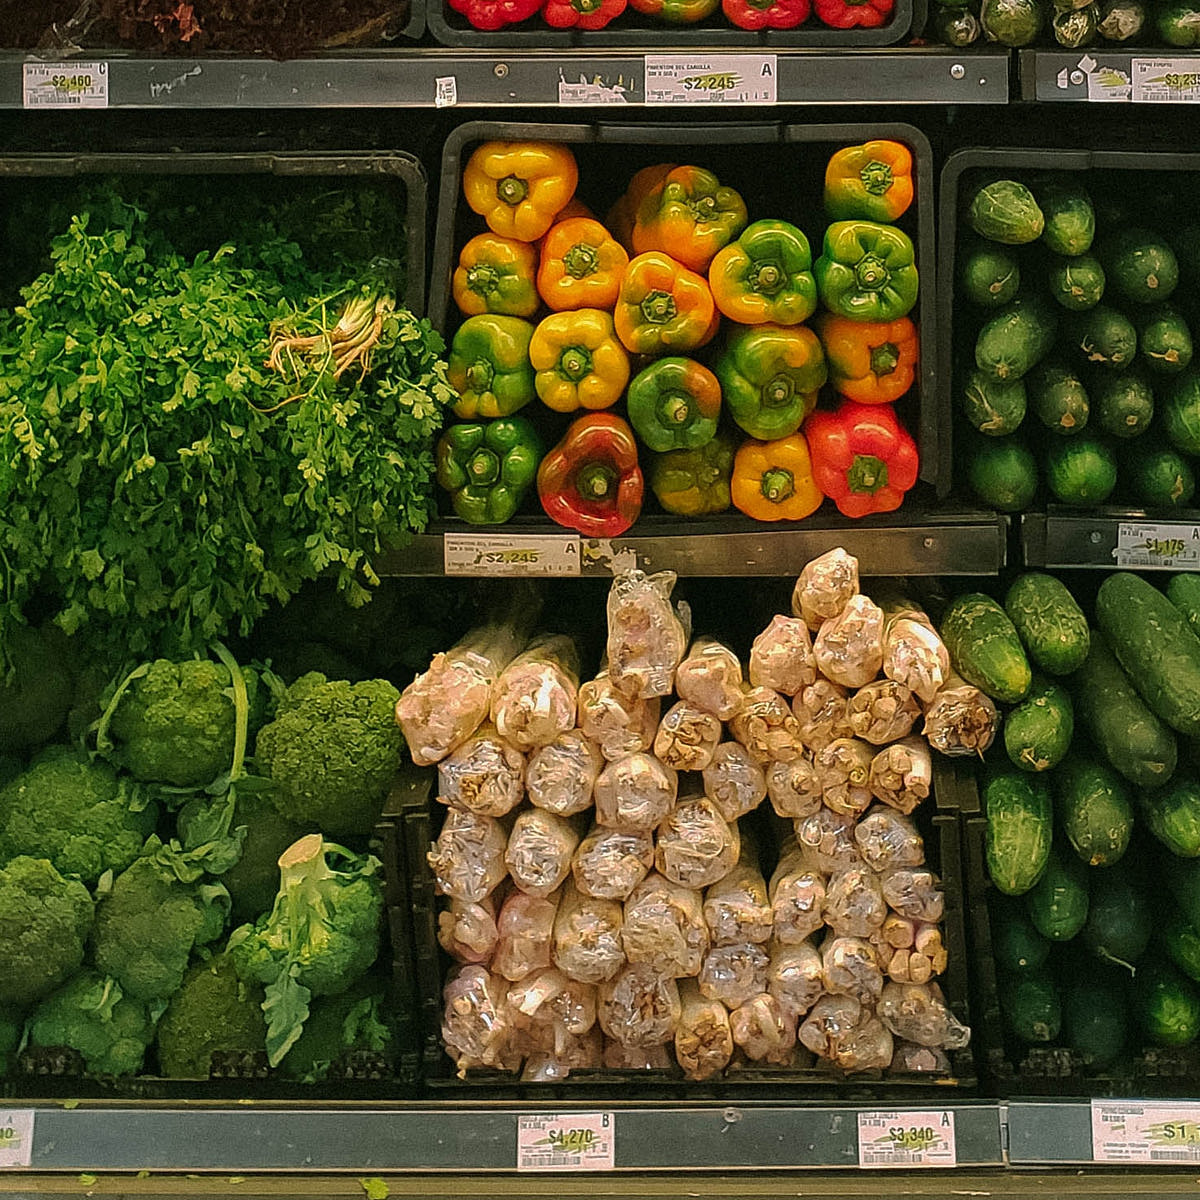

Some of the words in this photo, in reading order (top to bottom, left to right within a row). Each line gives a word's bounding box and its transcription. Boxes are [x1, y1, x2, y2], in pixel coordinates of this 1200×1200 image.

[99, 63, 106, 74] C
[762, 63, 772, 76] A
[52, 75, 91, 89] $2,460
[684, 77, 735, 91] $2,245
[1192, 528, 1199, 539] A
[565, 542, 576, 553] A
[486, 552, 538, 564] $2,245
[602, 1113, 609, 1127] B
[941, 1112, 950, 1126] A
[548, 1129, 593, 1145] $4,270
[889, 1127, 934, 1144] $3,340
